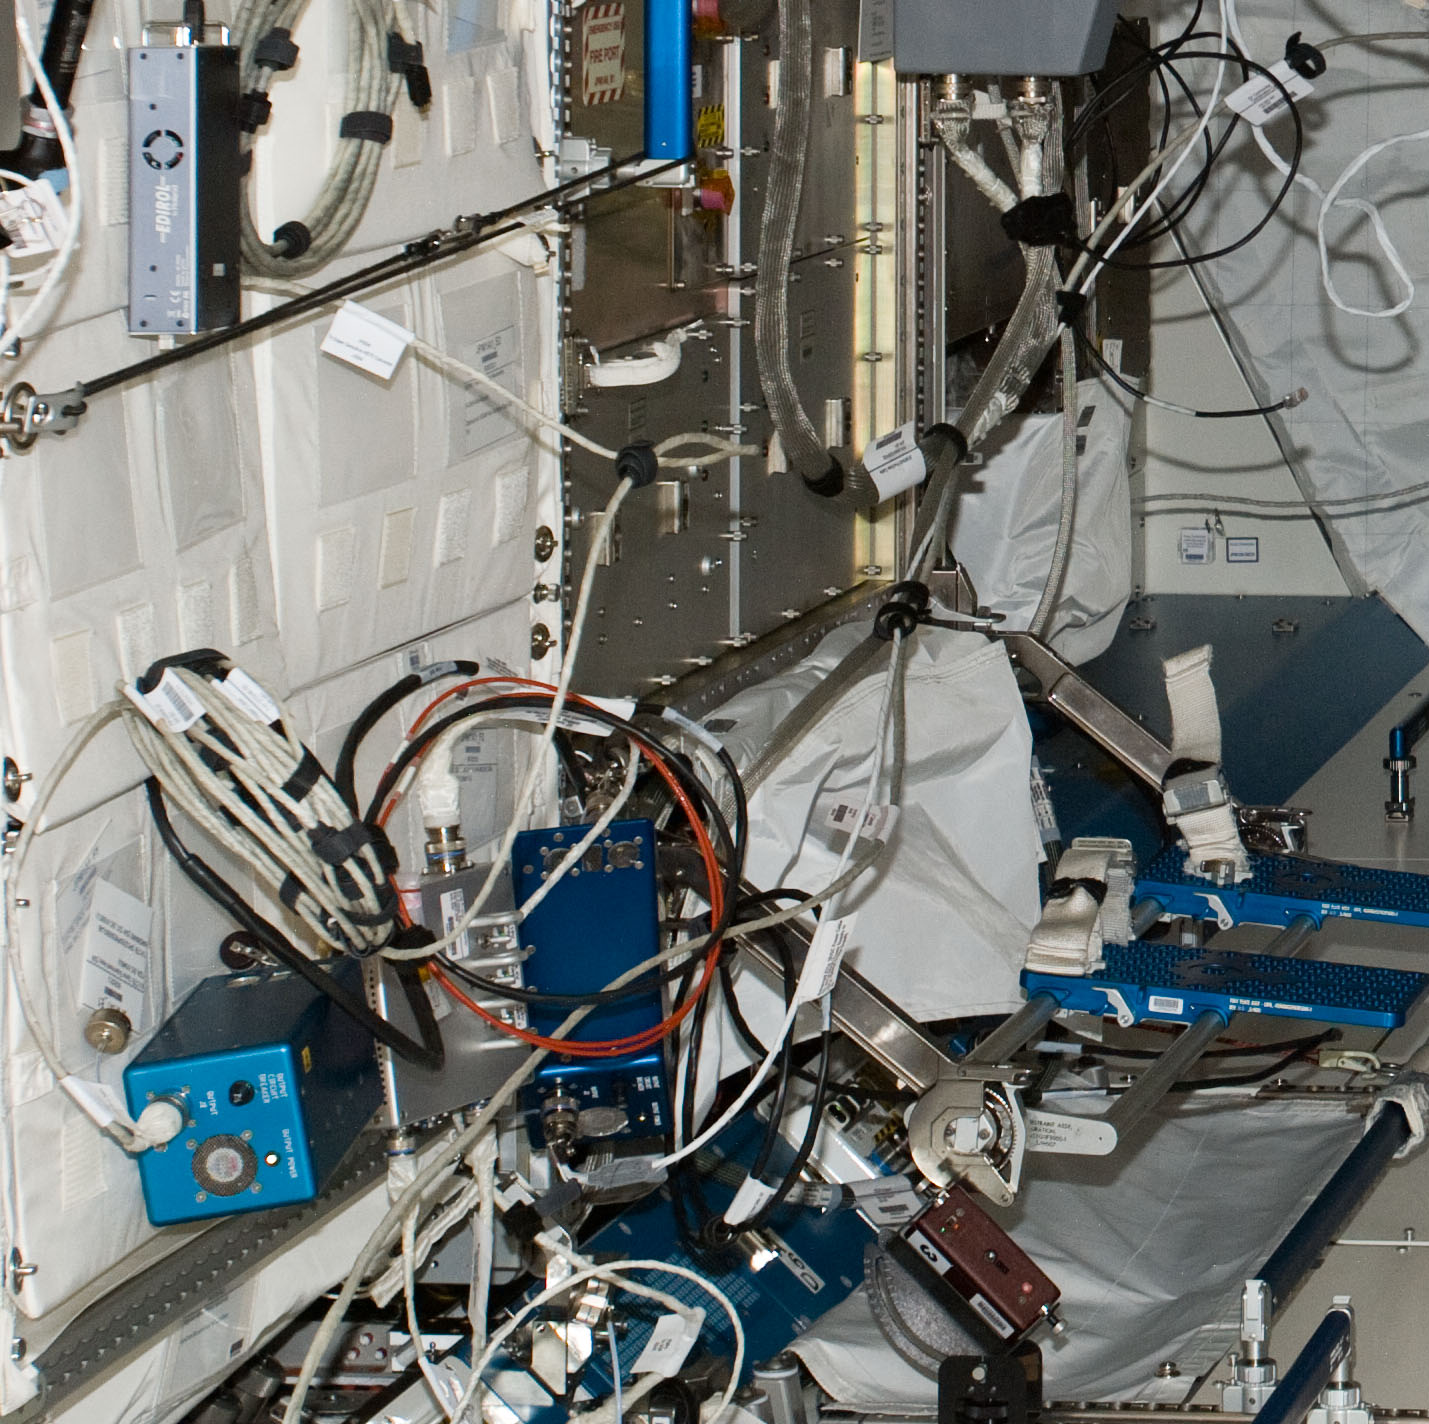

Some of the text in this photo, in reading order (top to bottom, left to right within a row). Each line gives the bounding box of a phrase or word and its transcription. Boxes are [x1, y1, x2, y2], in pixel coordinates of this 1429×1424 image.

[590, 46, 620, 64] FIRE PORT
[155, 184, 172, 233] EDIROL
[277, 1073, 288, 1098] OUTPUT
[206, 1090, 218, 1116] OUTPUT
[282, 1128, 298, 1179] OUTPUT POWER
[919, 1242, 938, 1263] 3
